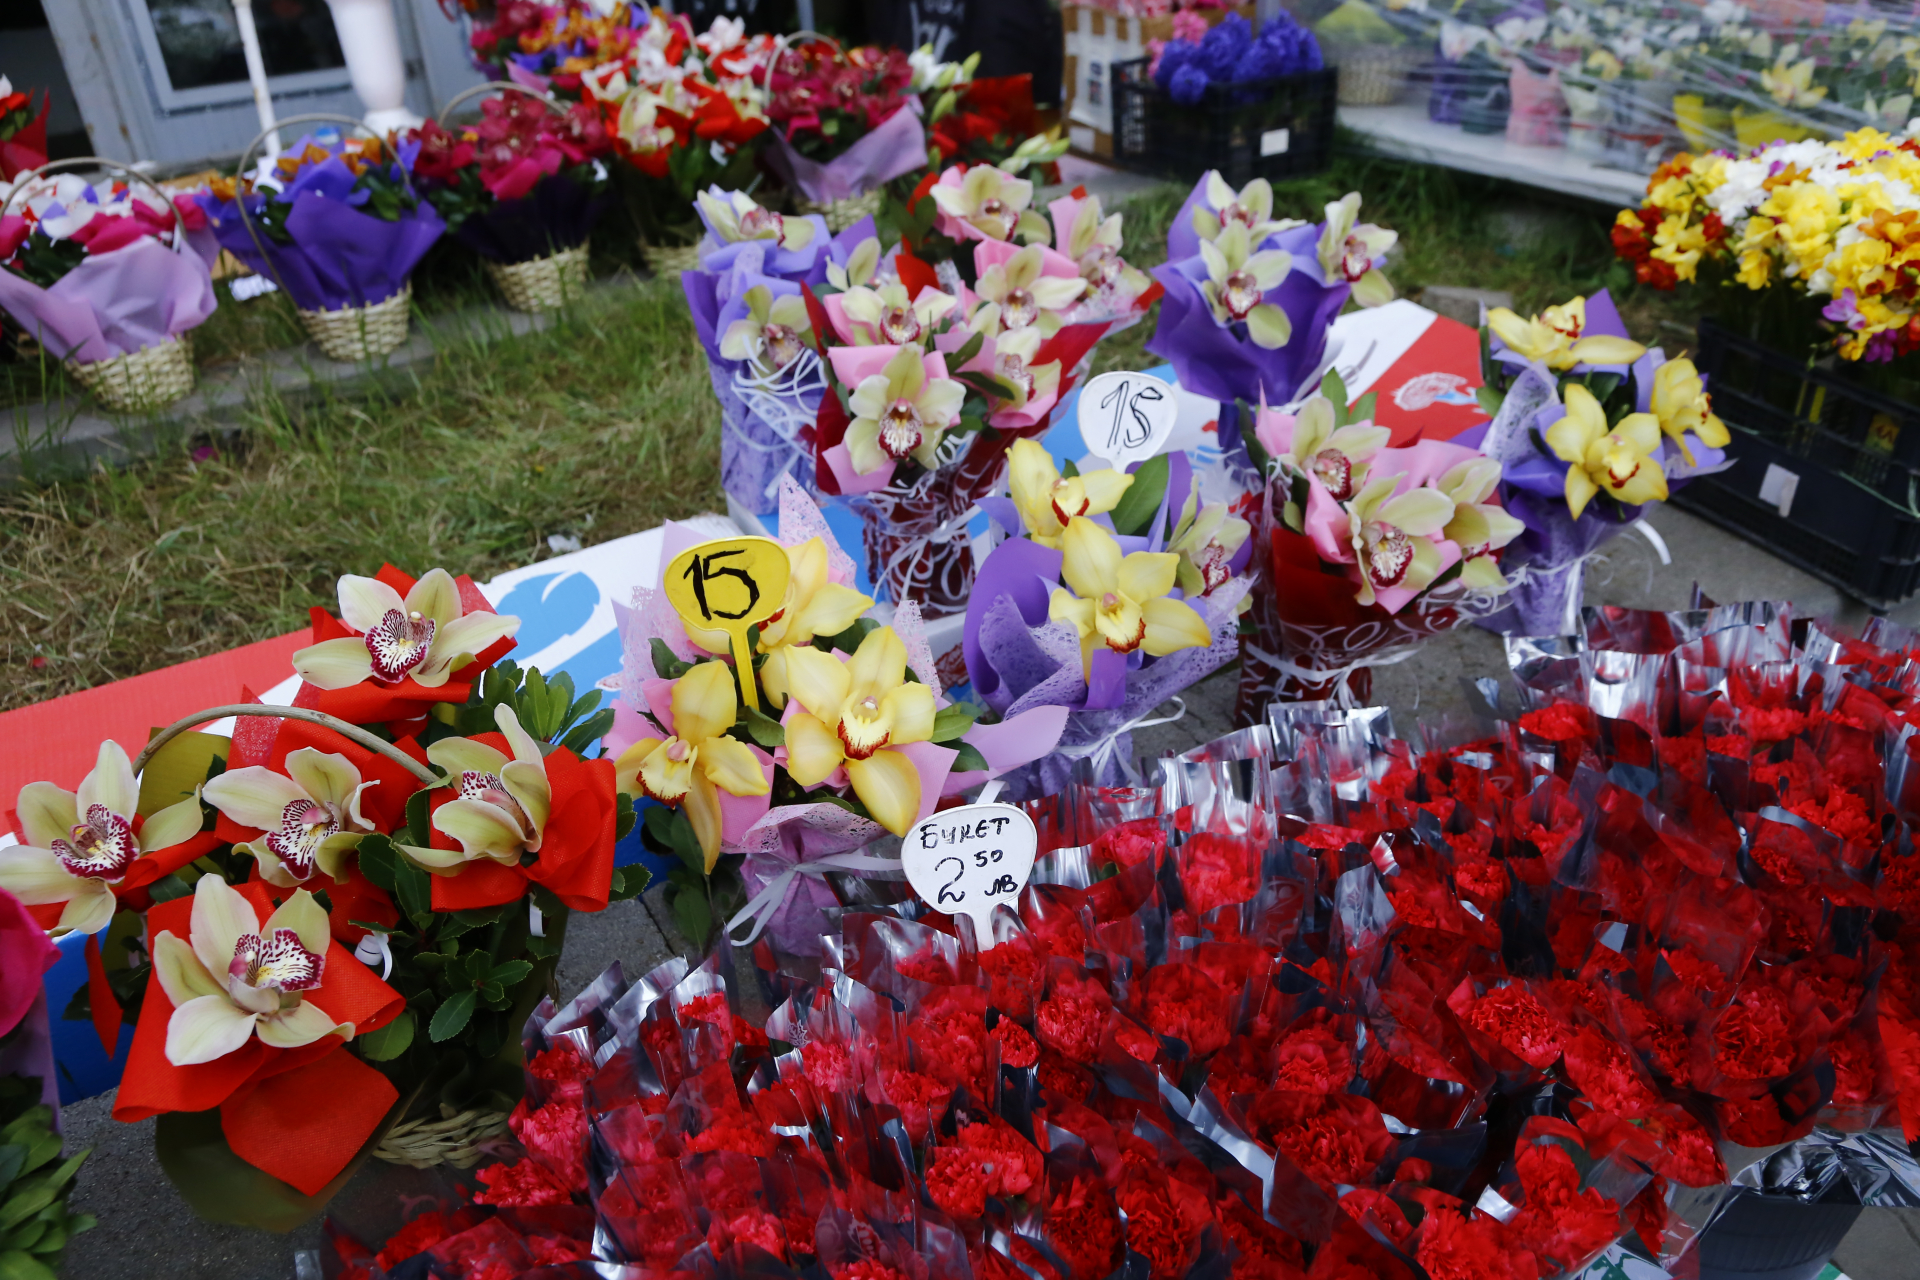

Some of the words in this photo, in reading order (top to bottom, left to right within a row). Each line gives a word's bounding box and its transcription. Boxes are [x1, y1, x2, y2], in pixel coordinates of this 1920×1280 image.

[1100, 380, 1164, 449] 15
[683, 548, 760, 621] 15
[934, 857, 966, 905] 2
[973, 849, 1004, 868] 50
